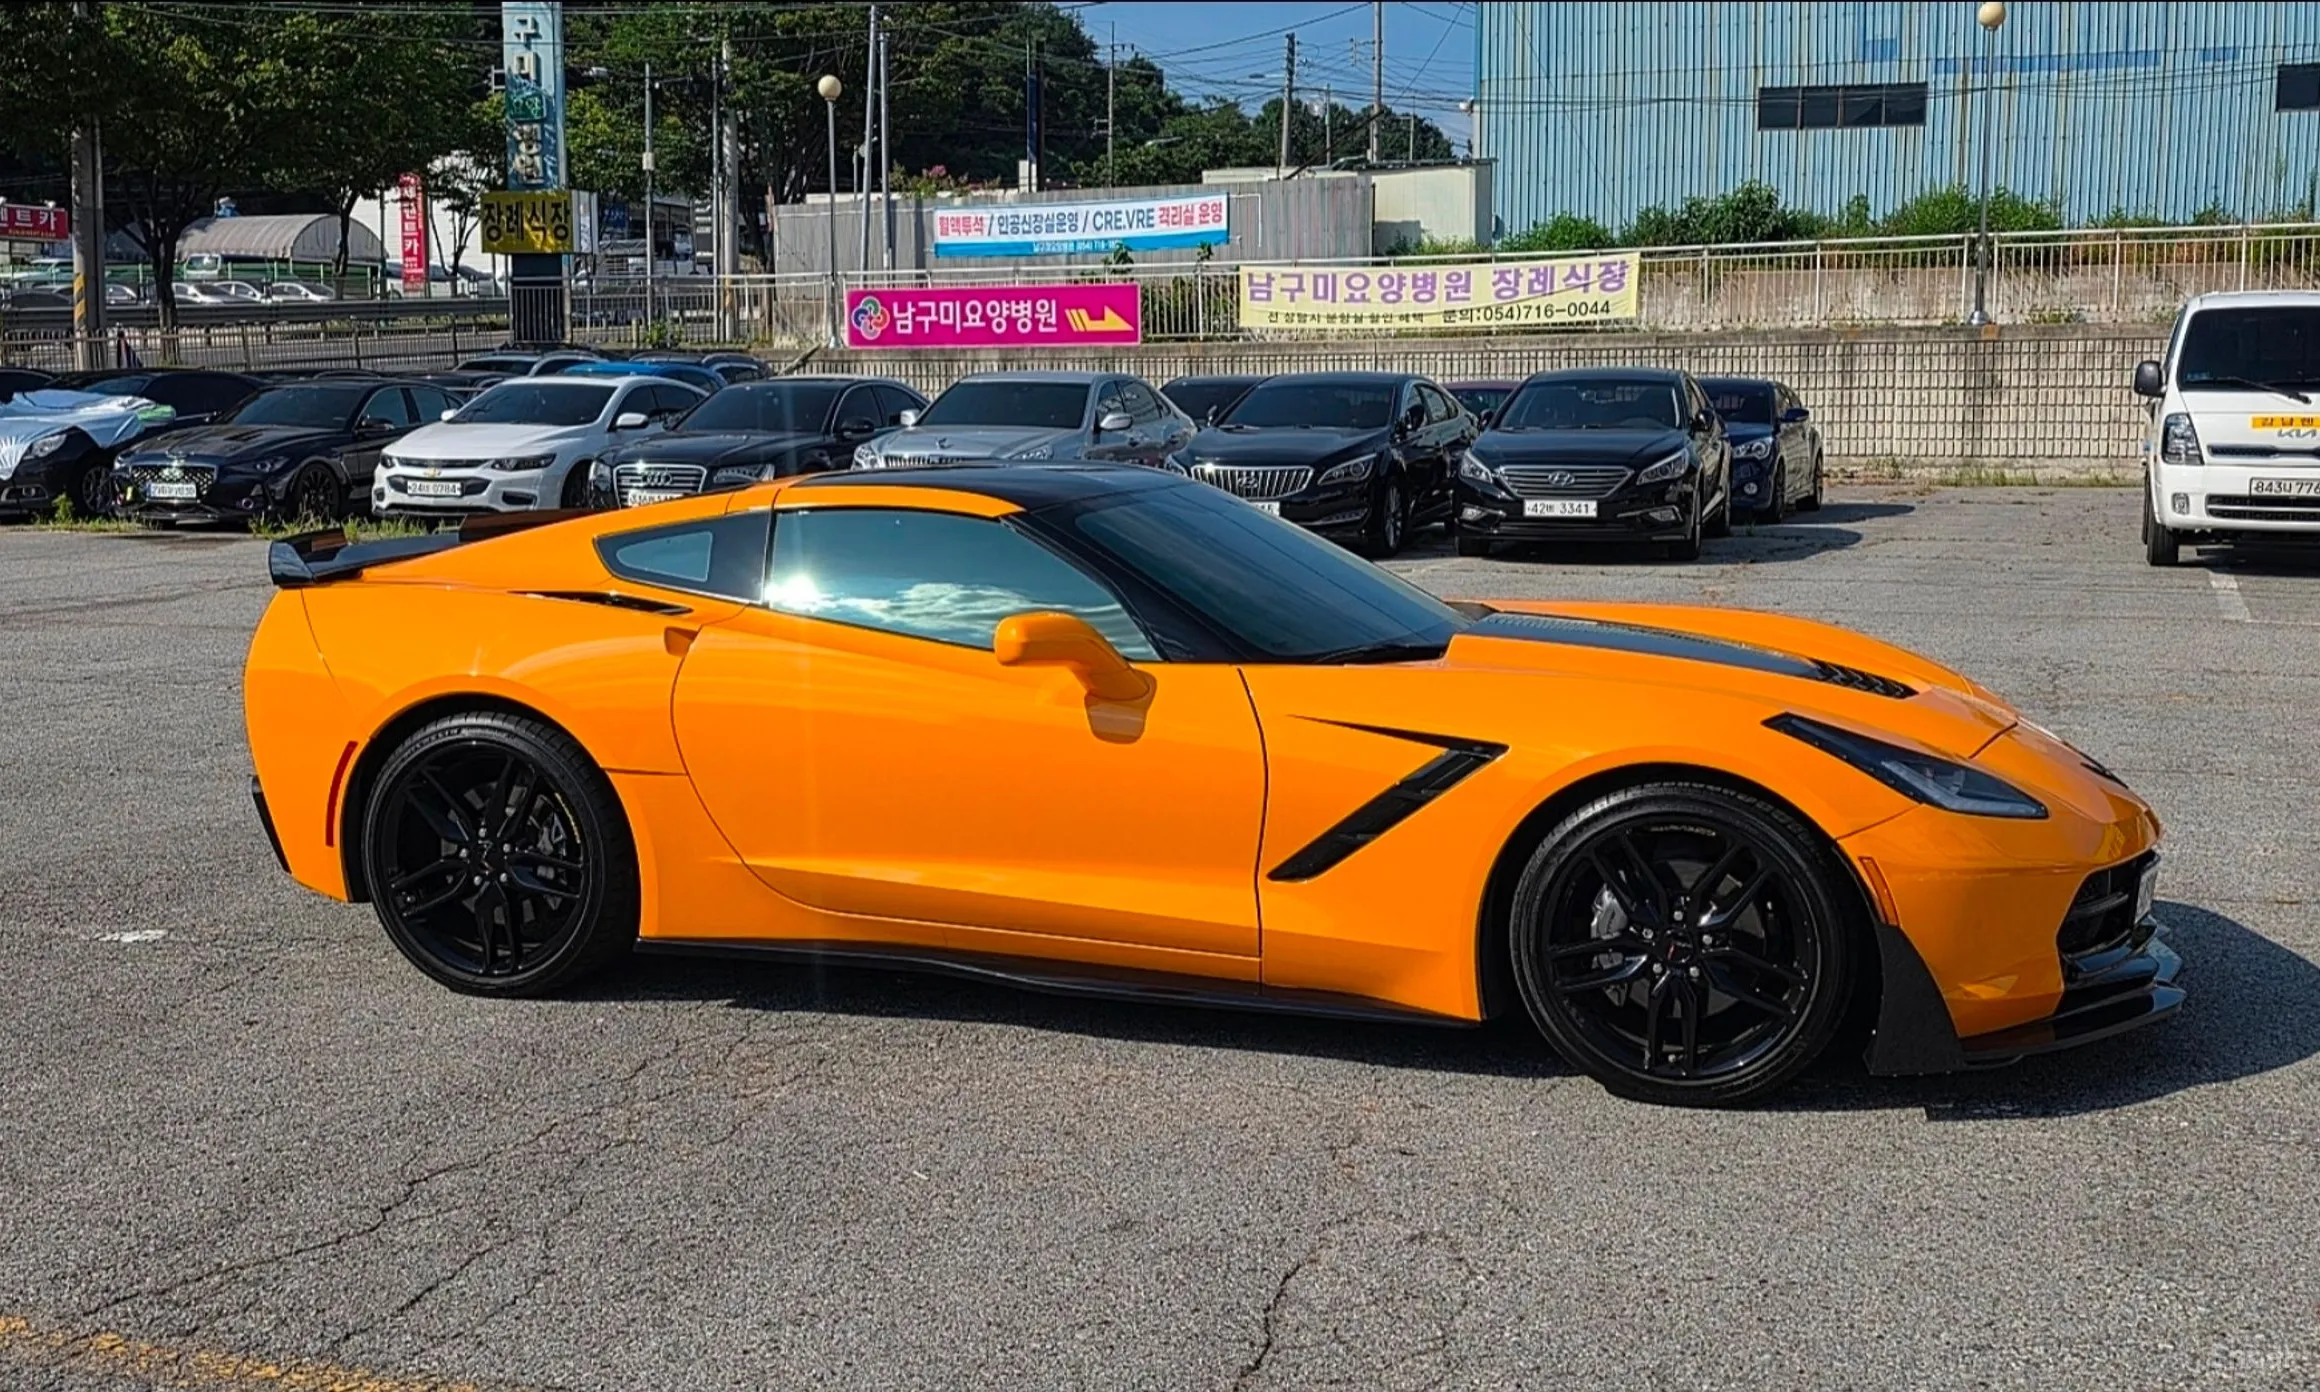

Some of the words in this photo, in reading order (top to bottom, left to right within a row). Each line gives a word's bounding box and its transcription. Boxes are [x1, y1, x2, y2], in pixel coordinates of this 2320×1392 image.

[484, 199, 571, 244] 장례식장
[938, 214, 984, 237] 혈액투석
[997, 211, 1079, 235] 인공신장실운영
[1092, 207, 1155, 232] CRE.VRE
[1158, 203, 1195, 227] 격리실
[1198, 200, 1223, 225] 운영
[1247, 270, 1472, 304] 남구미요양병원
[1491, 260, 1629, 301] 장례식장
[892, 298, 1057, 334] 남구미요양병원
